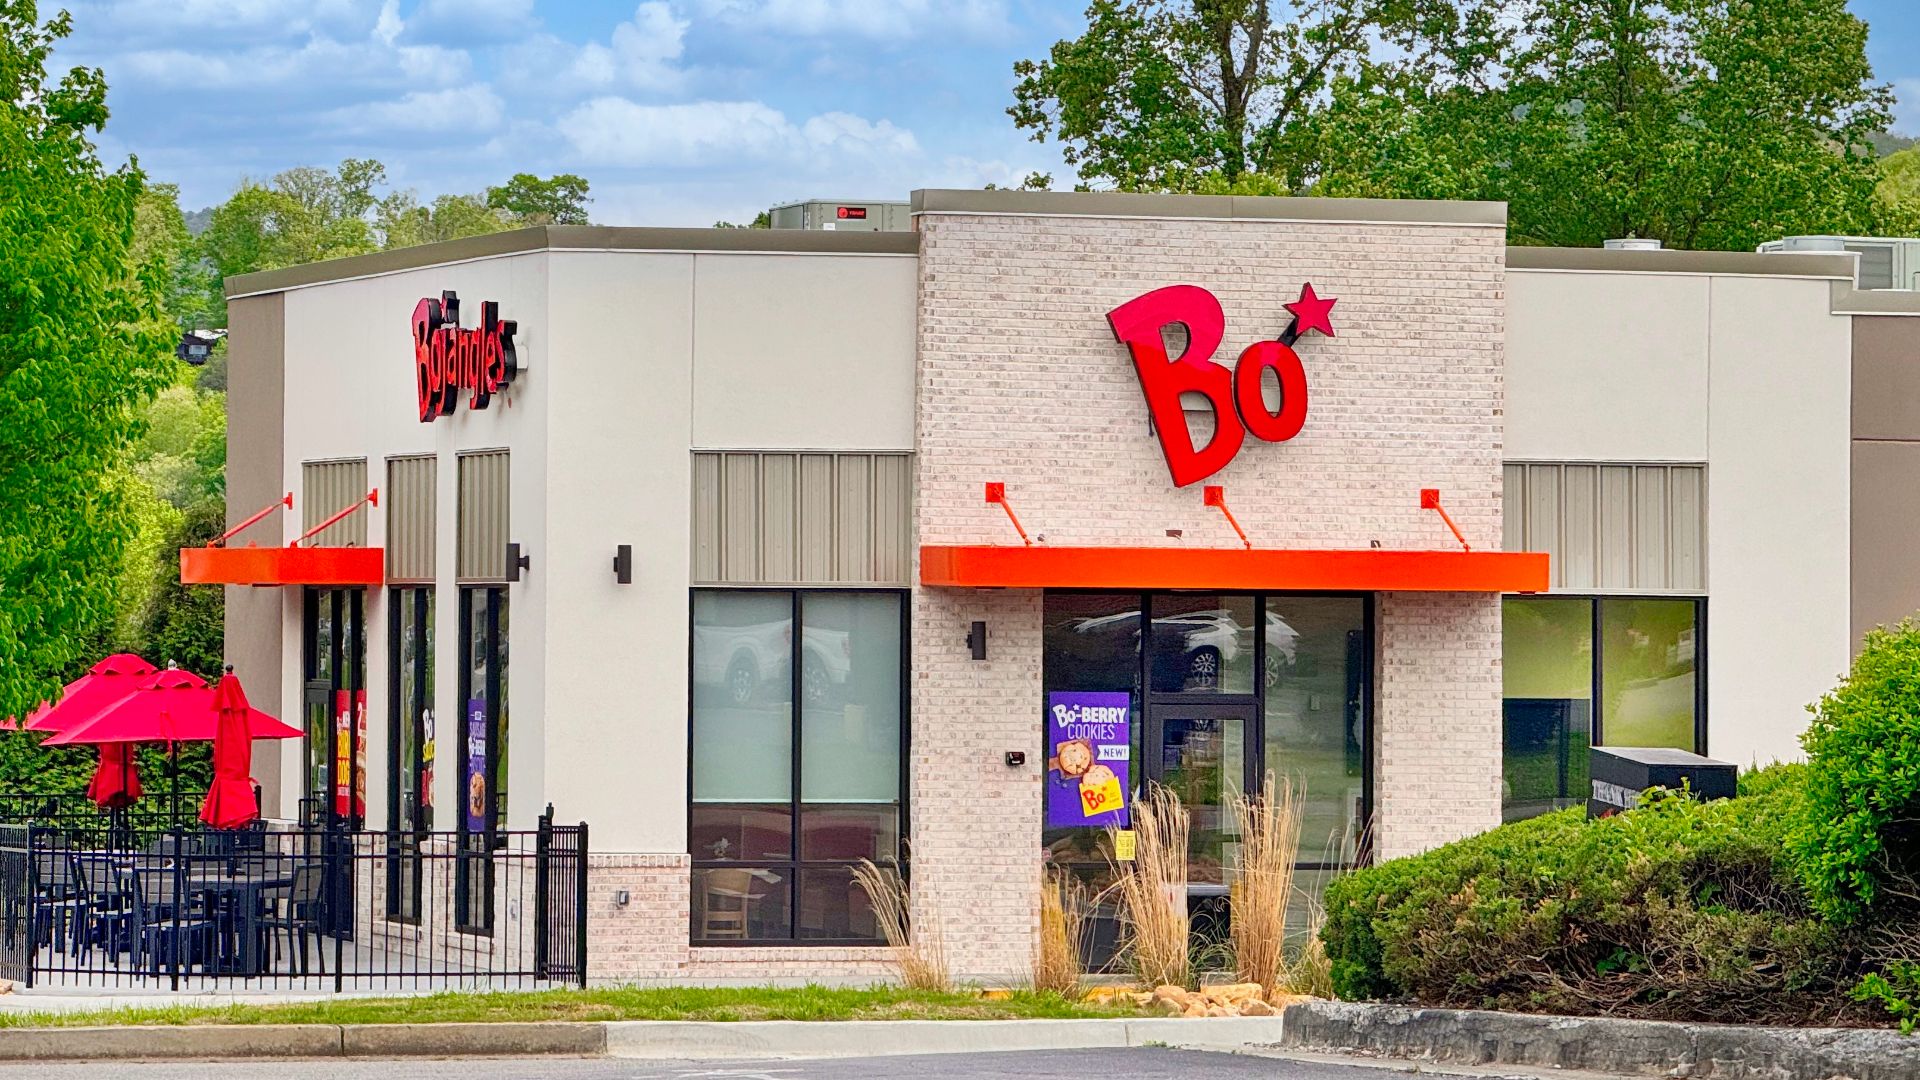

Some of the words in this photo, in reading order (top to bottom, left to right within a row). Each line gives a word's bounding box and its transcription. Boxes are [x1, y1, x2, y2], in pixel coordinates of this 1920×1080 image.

[412, 291, 517, 423] Bojangles
[1067, 723, 1116, 740] COOKIES
[1103, 747, 1127, 758] NEW!
